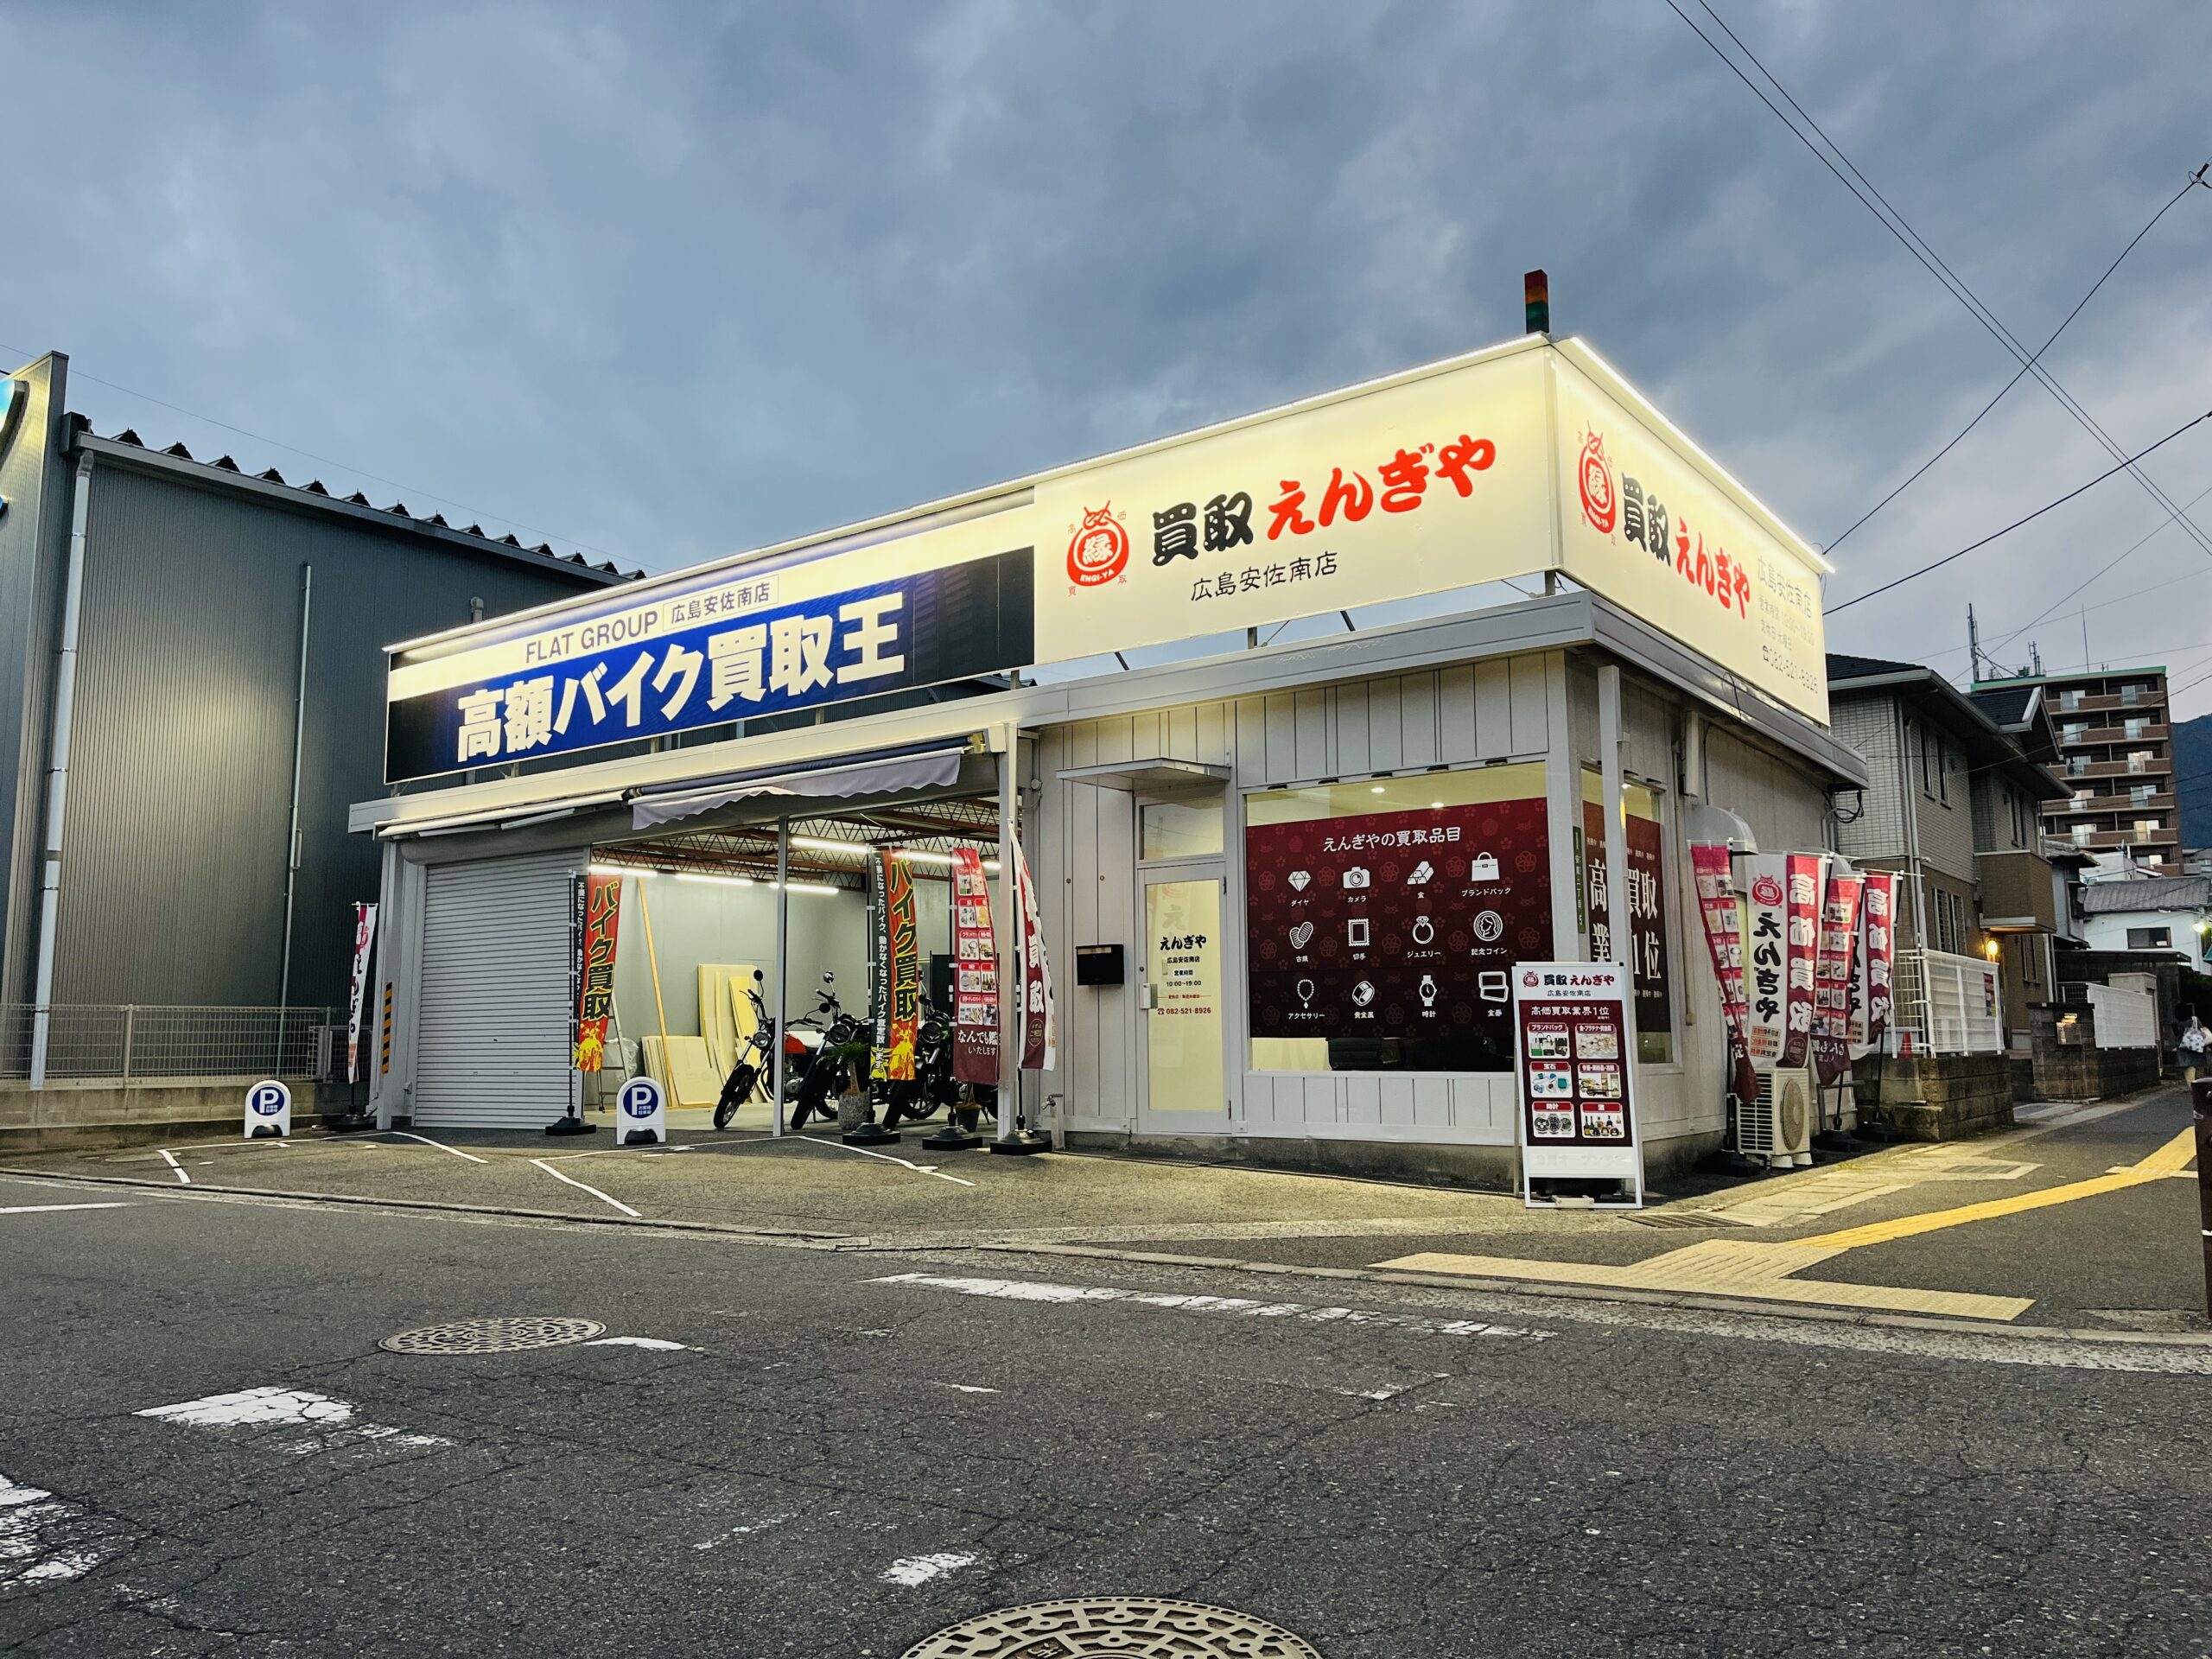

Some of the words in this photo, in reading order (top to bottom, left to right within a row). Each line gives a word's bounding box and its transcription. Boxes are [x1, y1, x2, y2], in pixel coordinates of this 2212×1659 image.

[1153, 492, 1254, 567] 買取
[1267, 434, 1496, 541] えんぎや
[1083, 533, 1114, 565] 縁
[1621, 471, 1671, 567] 買取
[1675, 515, 1750, 620] えんぎや
[1080, 569, 1115, 582] ENGI-YA
[1190, 551, 1338, 602] 広島安佐南店
[1758, 554, 1812, 620] 広島安佐南店
[671, 582, 771, 625] 広島安佐南店
[524, 630, 575, 664] FLAT
[580, 610, 659, 651] GROUP
[457, 591, 906, 763] 高額バイク買取王
[1323, 827, 1461, 852] えんぎやの買取品目
[582, 880, 619, 1021] バイク買取
[890, 856, 917, 1021] バイク買取
[1160, 935, 1206, 950] えんぎや
[1544, 975, 1567, 985] 買取
[1570, 974, 1615, 986] えんぎや
[1531, 1006, 1610, 1016] 高価買取業界1位
[968, 1046, 996, 1056] いたします
[259, 1089, 279, 1114] P
[632, 1087, 652, 1116] P
